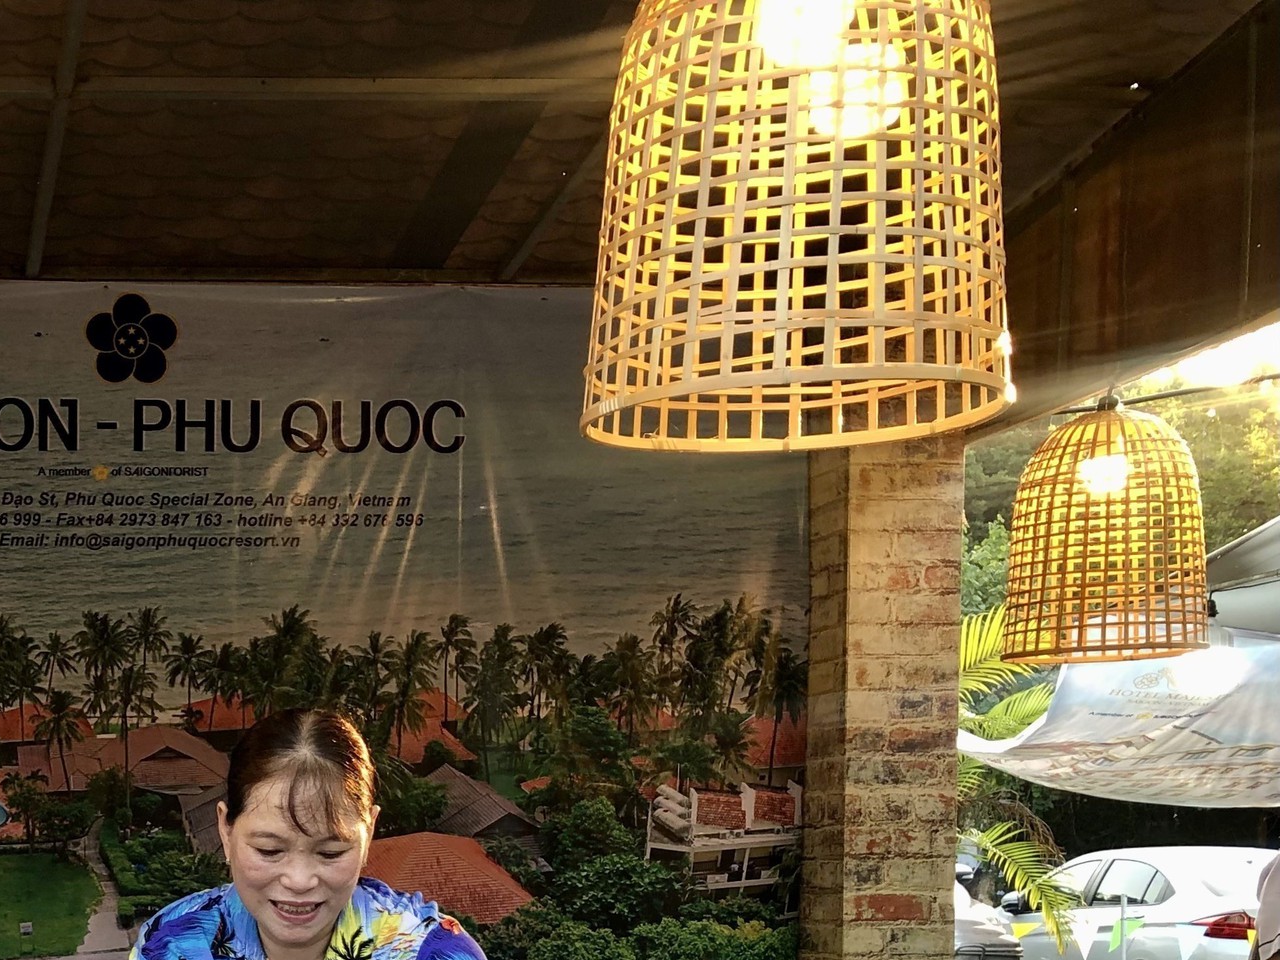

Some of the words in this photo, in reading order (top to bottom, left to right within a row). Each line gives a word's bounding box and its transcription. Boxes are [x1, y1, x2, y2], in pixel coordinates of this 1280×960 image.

[132, 398, 262, 453] PHU
[280, 398, 467, 457] QUOC
[37, 466, 47, 477] A
[49, 466, 91, 477] member
[111, 466, 122, 477] of
[2, 492, 34, 509] Đạo
[39, 493, 59, 508] St,
[150, 493, 209, 509] Special
[214, 493, 258, 509] Zone,
[262, 493, 285, 506] An
[290, 493, 342, 509] Giang,
[348, 493, 411, 507] Vietnam
[13, 512, 41, 526] 999
[56, 513, 114, 527] Fax+84
[119, 513, 156, 527] 2973
[161, 513, 189, 527] 847
[195, 513, 222, 527] 163
[237, 513, 293, 528] hotline
[297, 514, 326, 527] +84
[395, 514, 424, 527] 596
[0, 534, 50, 547] Email:
[54, 534, 300, 550] info@saigonphuquocresort.vn
